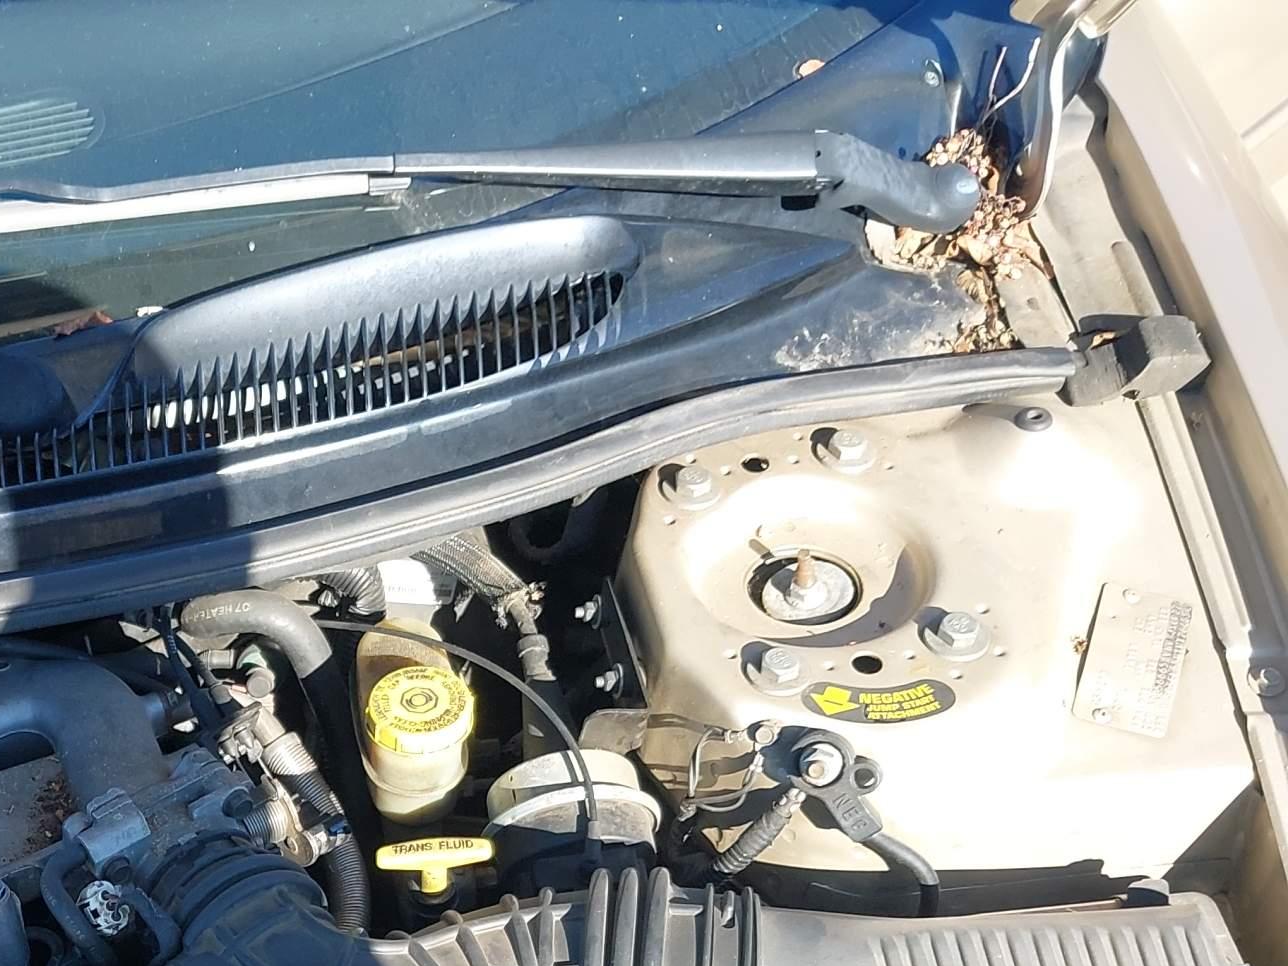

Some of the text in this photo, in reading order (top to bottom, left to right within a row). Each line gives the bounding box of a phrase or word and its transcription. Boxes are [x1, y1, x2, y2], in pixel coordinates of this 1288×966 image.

[859, 684, 935, 705] NEGATIVE
[867, 695, 935, 712] JUMP START
[867, 702, 942, 720] ATTACHMENT
[833, 793, 868, 830] NEG
[392, 840, 474, 855] TRANS FLUID
